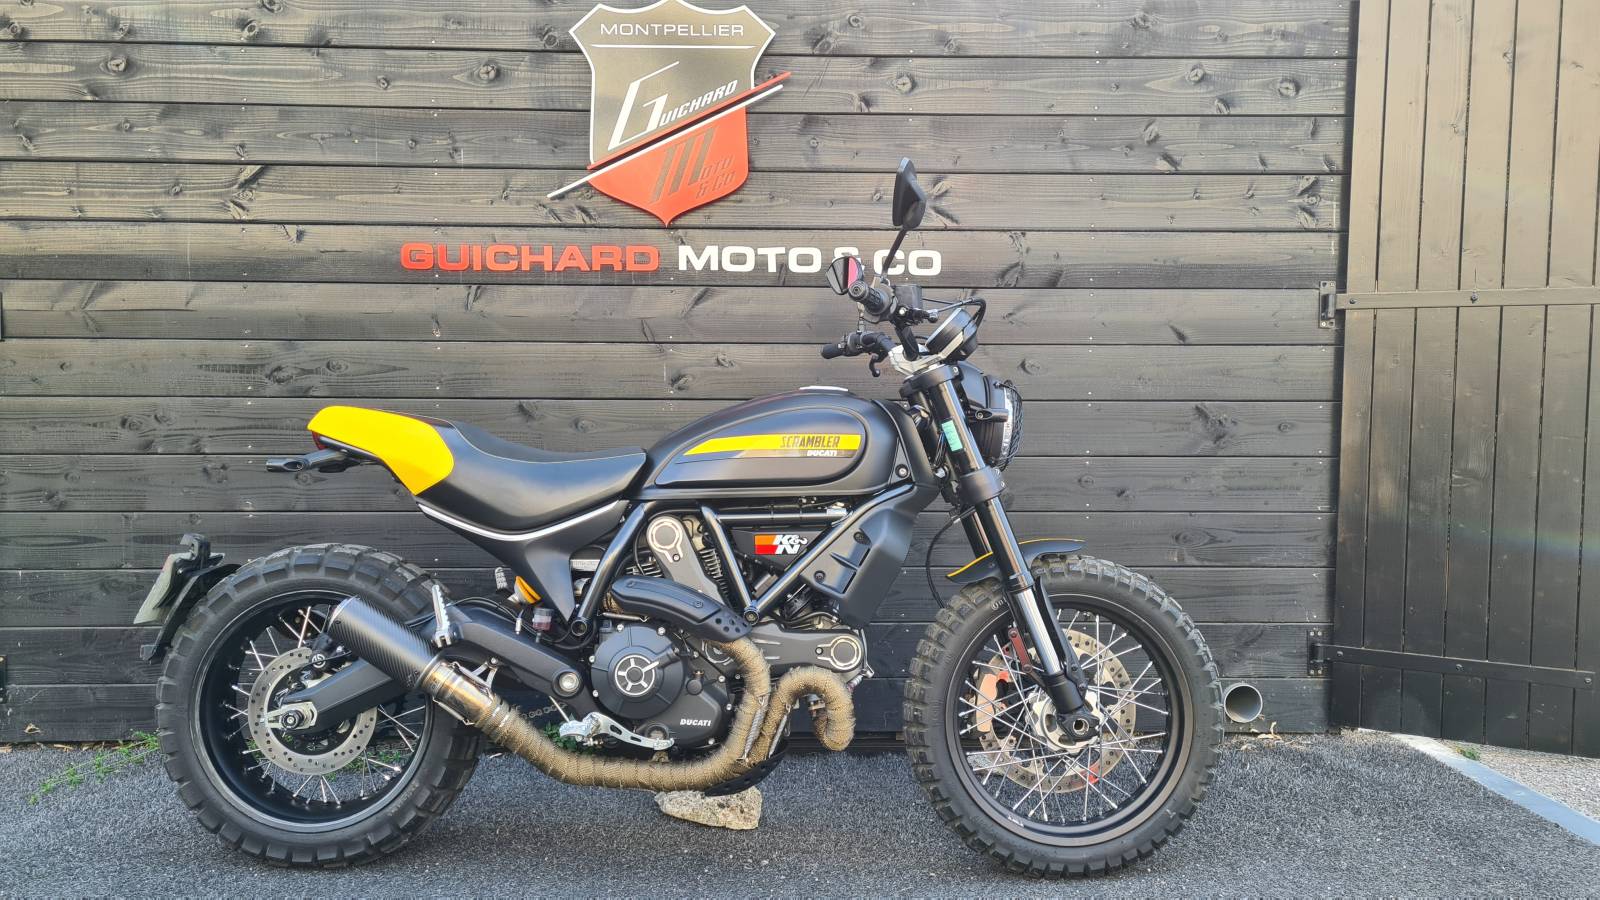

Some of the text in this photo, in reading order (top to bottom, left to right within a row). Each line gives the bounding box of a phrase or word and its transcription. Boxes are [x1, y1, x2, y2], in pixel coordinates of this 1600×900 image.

[600, 23, 745, 37] MONTPELLIER
[607, 61, 739, 152] GUICHARD
[400, 242, 660, 272] GUICHARD
[678, 245, 822, 273] MOTO
[873, 249, 942, 276] CO
[780, 436, 841, 448] SCRAMBLER
[806, 449, 838, 457] DUCATI
[679, 718, 712, 727] DUCATI
